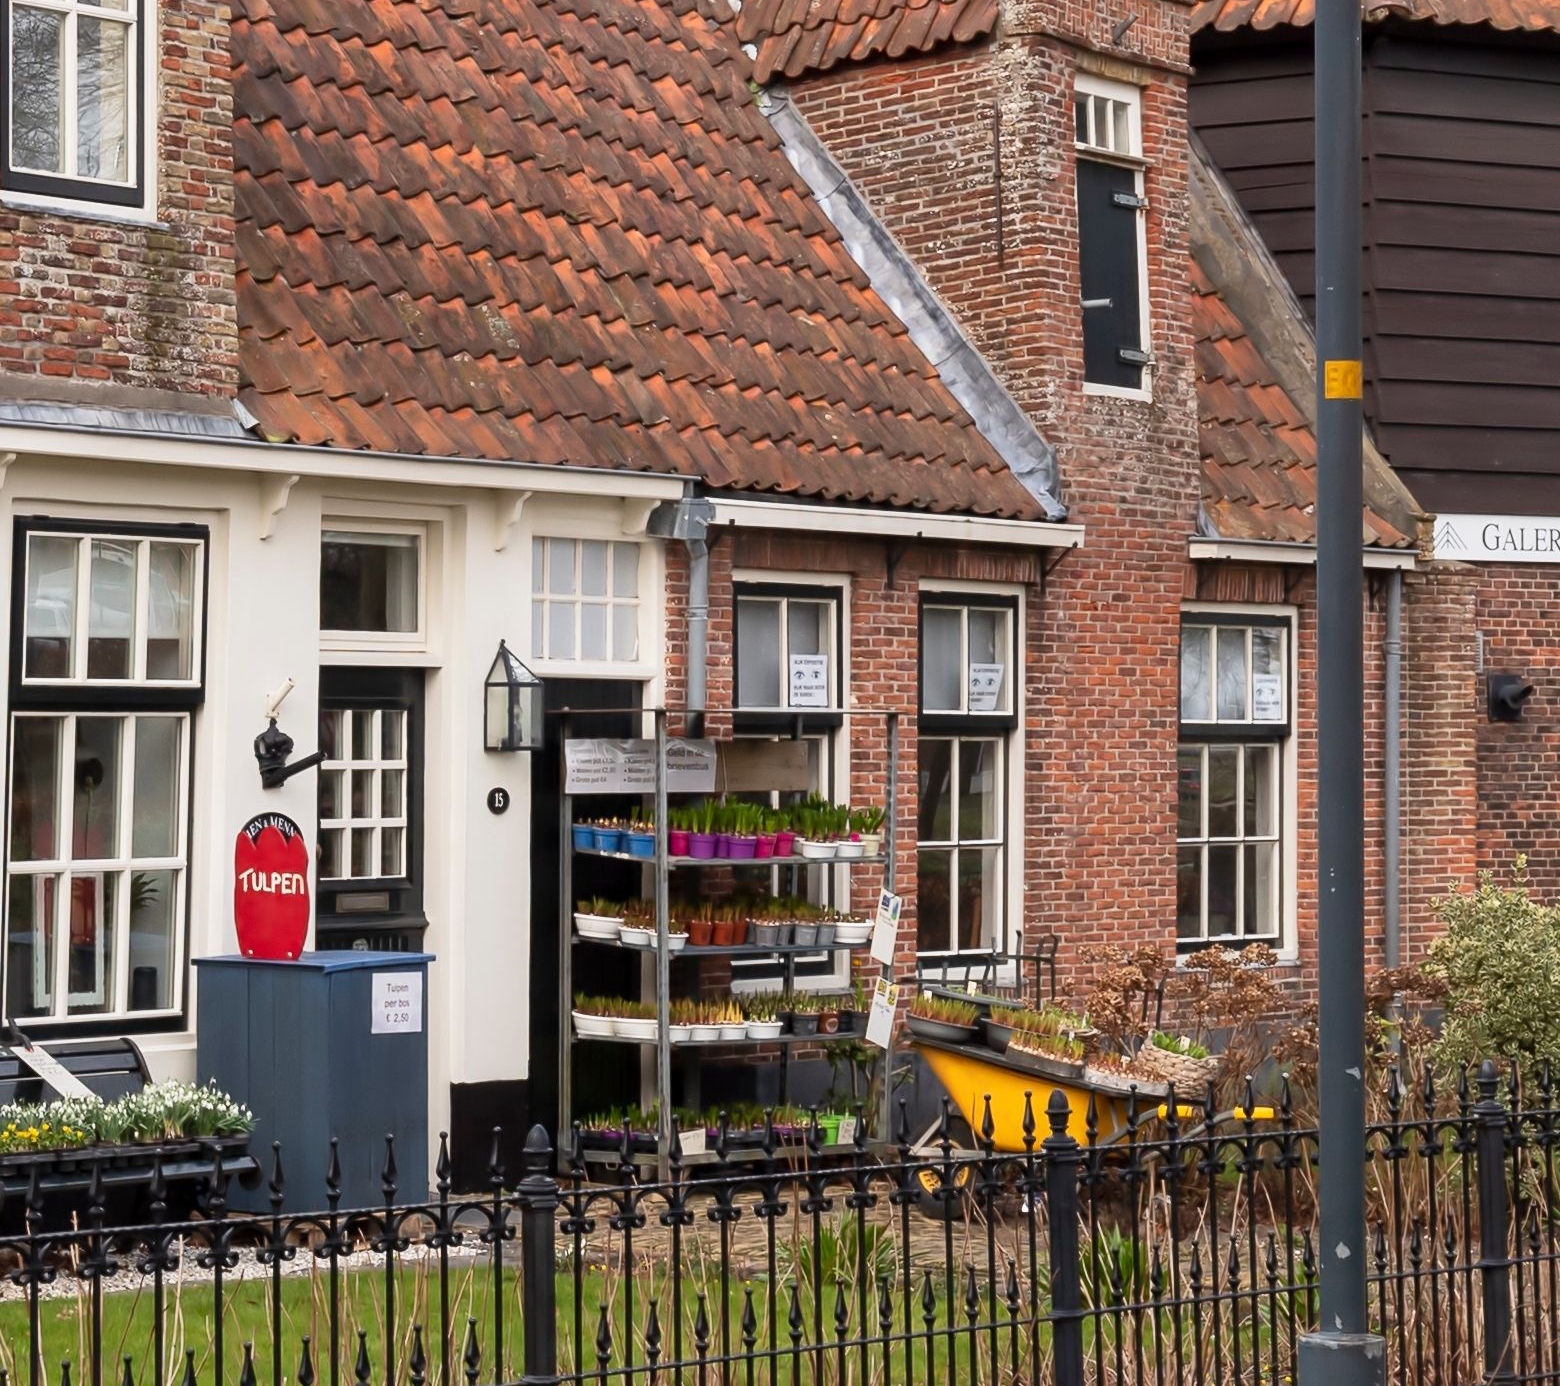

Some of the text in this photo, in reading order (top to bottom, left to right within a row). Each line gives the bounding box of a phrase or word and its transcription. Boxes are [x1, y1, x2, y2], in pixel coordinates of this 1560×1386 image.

[495, 792, 504, 808] 15
[239, 868, 305, 895] TULPEN
[384, 998, 410, 1009] per bos
[393, 1012, 409, 1023] 2,50
